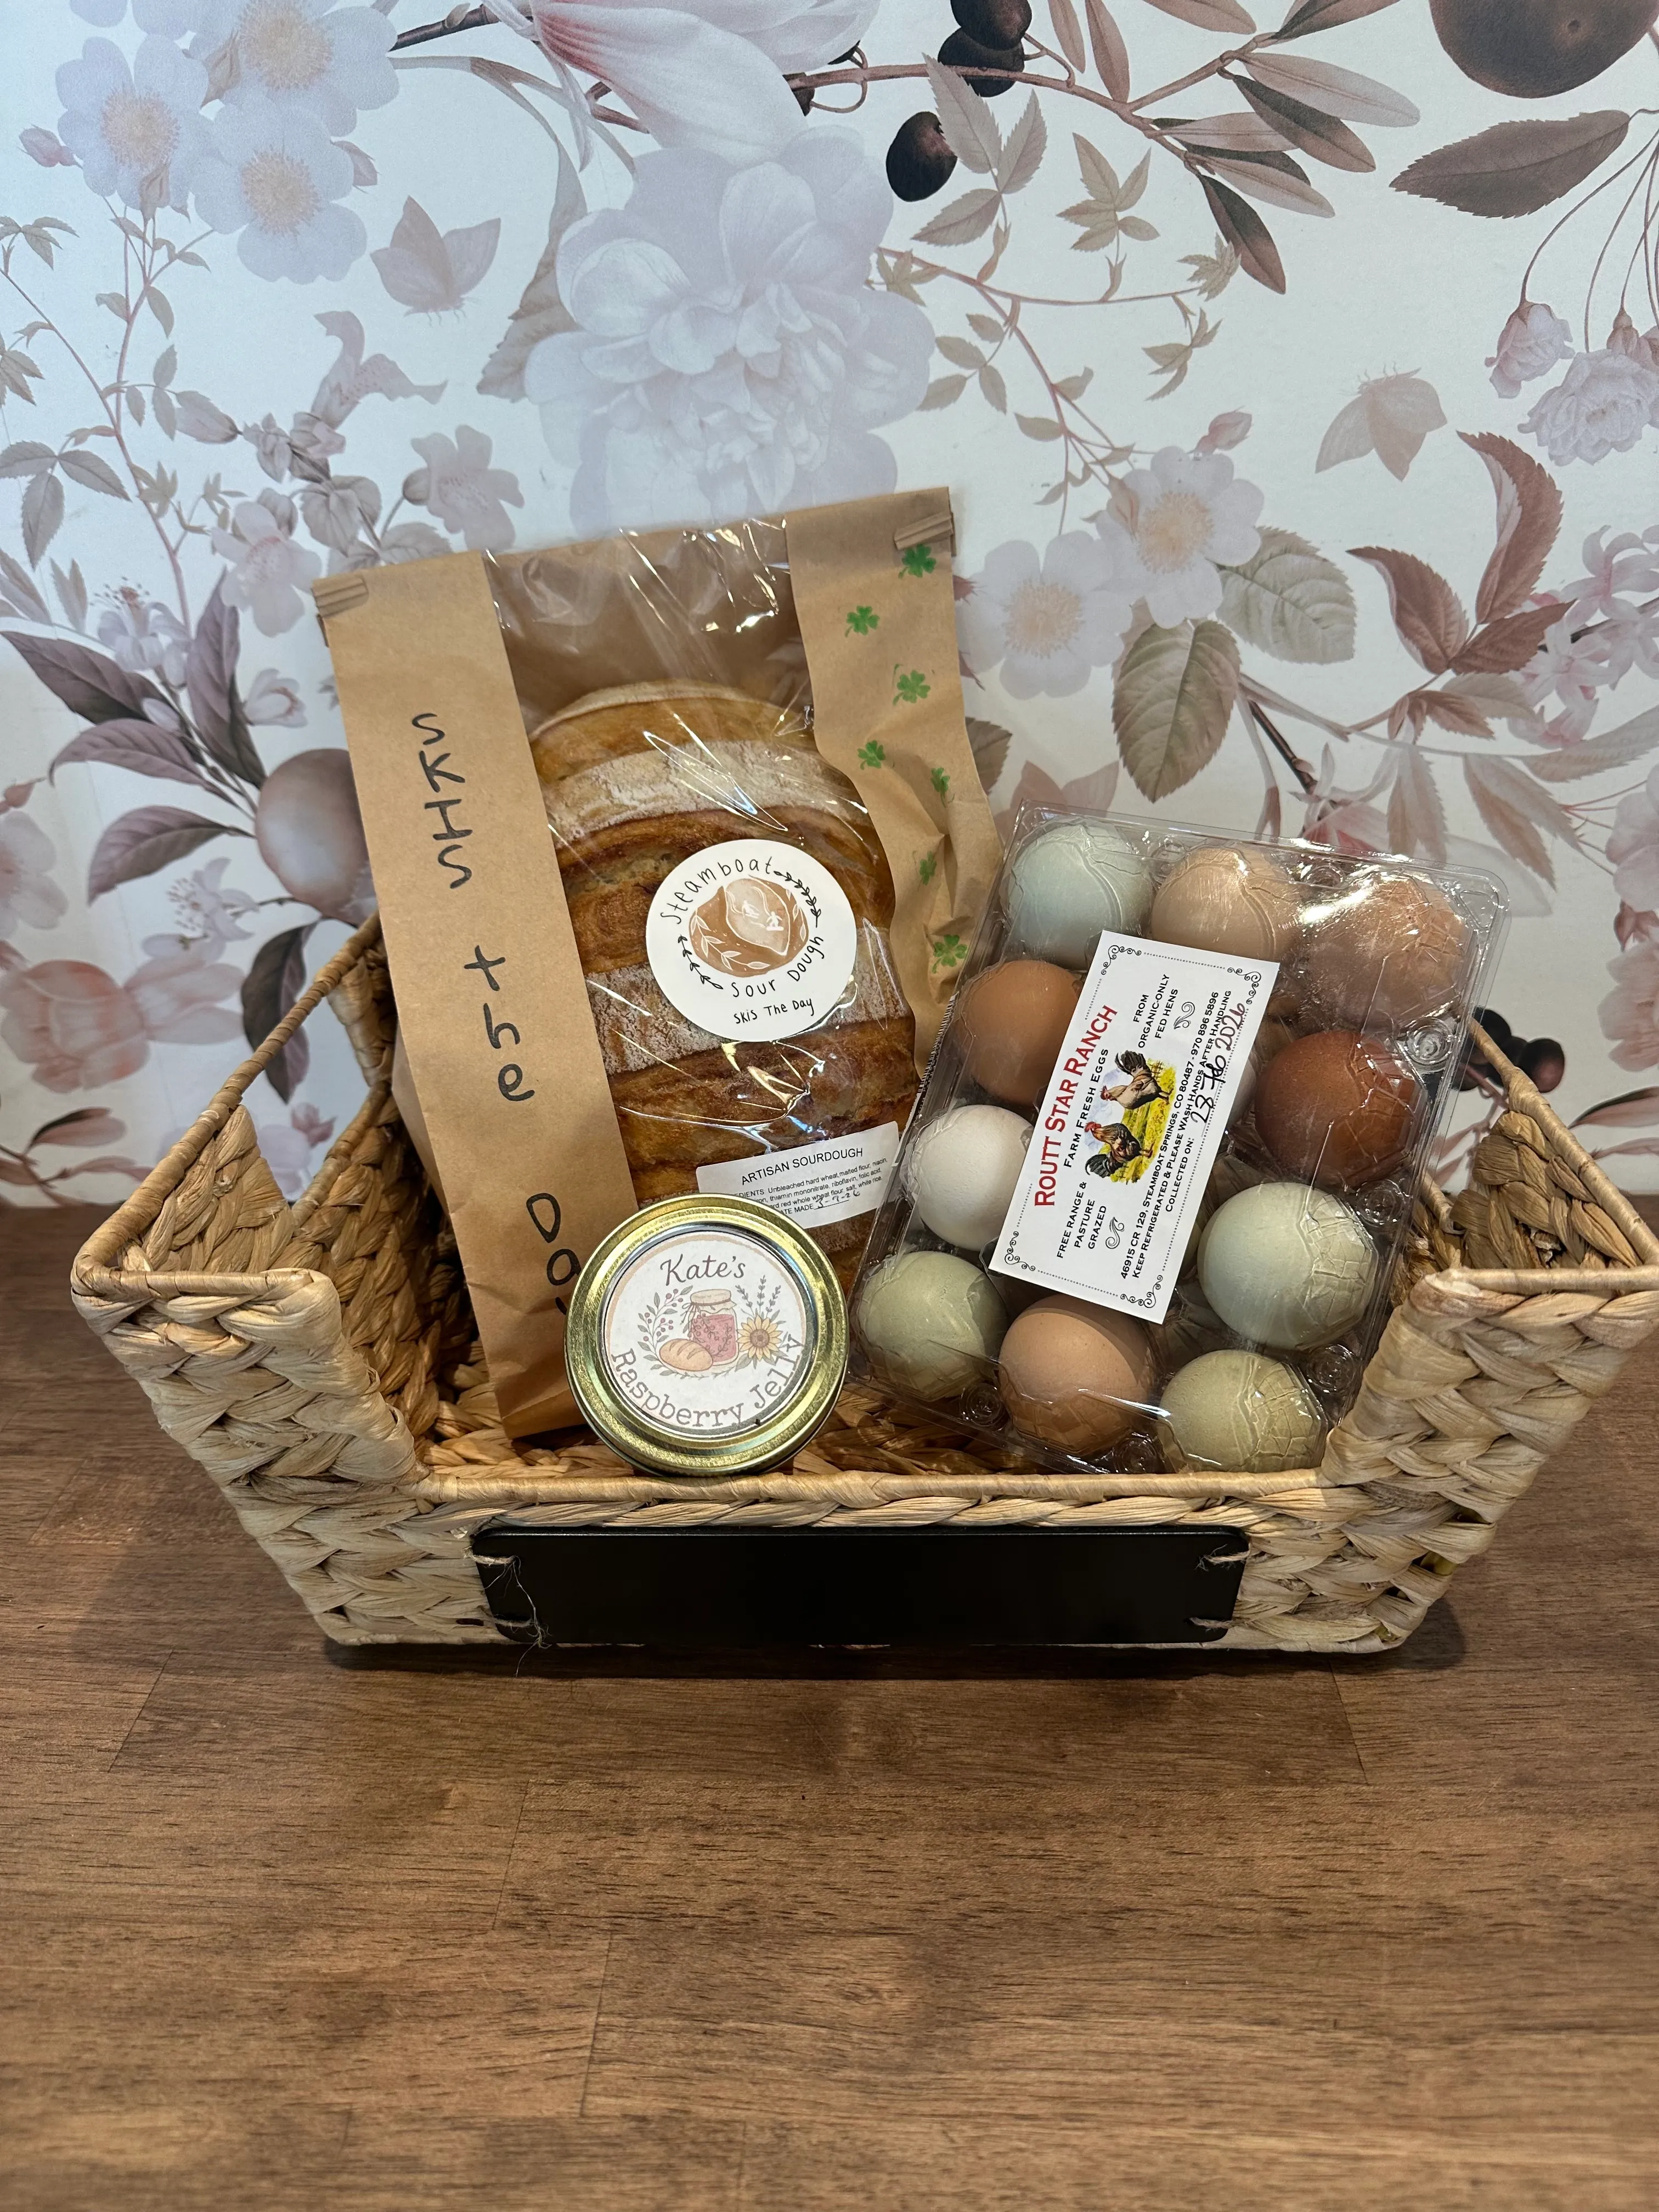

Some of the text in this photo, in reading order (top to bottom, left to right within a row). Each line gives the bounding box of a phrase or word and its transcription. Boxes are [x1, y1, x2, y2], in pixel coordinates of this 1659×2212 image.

[661, 856, 772, 924] Steamboat
[732, 937, 825, 997] Sour Dough
[763, 1003, 788, 1016] The
[792, 998, 815, 1017] Day
[1133, 995, 1149, 1022] FROM
[1138, 974, 1169, 1048] ORGANIC-ONLY
[1155, 989, 1178, 1039] FED HENS
[1190, 1094, 1216, 1124] 28
[1215, 1002, 1248, 1051] 2026
[464, 945, 534, 1102] the
[526, 1193, 582, 1315] Da
[1035, 1006, 1118, 1206] ROUTT STAR RANCH
[1064, 1049, 1108, 1167] FARM FRESH EGGS
[1121, 1249, 1135, 1279] 46915
[1131, 1232, 1141, 1246] CR
[1136, 1210, 1148, 1228] 129,
[1143, 1153, 1164, 1207] STEAMBOAT
[1160, 1111, 1180, 1152] SPRINGS,
[1174, 1094, 1183, 1108] CO
[1179, 1061, 1194, 1092] 80487
[1191, 1038, 1202, 1055] 970
[1198, 1018, 1209, 1035] 896
[1205, 992, 1218, 1015] 5896
[1132, 1253, 1145, 1278] KEEP
[1141, 1181, 1167, 1250] REFRIGERATED
[1166, 1133, 1183, 1169] PLEASE
[1178, 1104, 1193, 1130] WASH
[1188, 1070, 1204, 1102] HANDS
[1199, 1039, 1214, 1068] AFTER
[1210, 991, 1231, 1036] HANDLING
[742, 1148, 863, 1185] ARTISAN SOURDOUGH
[768, 1181, 805, 1193] Unbleached
[806, 1177, 820, 1185] hard
[839, 1166, 857, 1177] malted
[812, 1192, 830, 1200] wheat
[1166, 1138, 1194, 1212] COLLECTED ON:
[770, 1193, 792, 1201] thiamin
[794, 1203, 814, 1213] MADE
[1057, 1231, 1071, 1258] FREE
[1066, 1191, 1084, 1228] RANGE
[1074, 1199, 1095, 1248] PASTURE
[1088, 1206, 1106, 1249] GRAZED
[660, 1254, 746, 1286] Kate's
[611, 1334, 805, 1428] Raspberry Jelly
